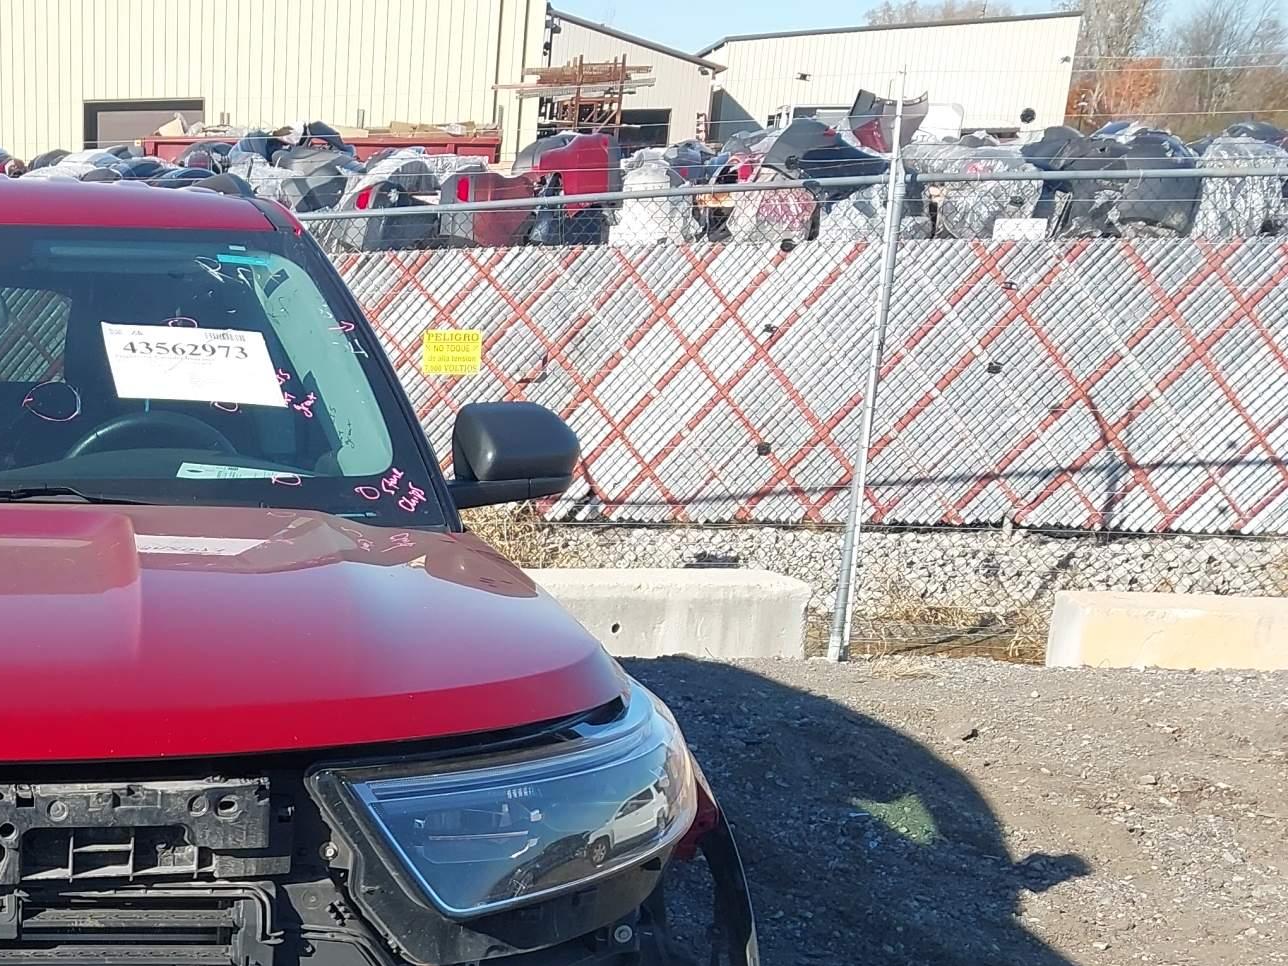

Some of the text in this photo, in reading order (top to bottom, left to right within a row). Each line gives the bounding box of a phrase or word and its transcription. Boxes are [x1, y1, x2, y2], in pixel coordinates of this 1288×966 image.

[427, 333, 480, 342] PELIGRO
[122, 340, 249, 360] 43562973
[433, 344, 471, 352] NO TOQUE
